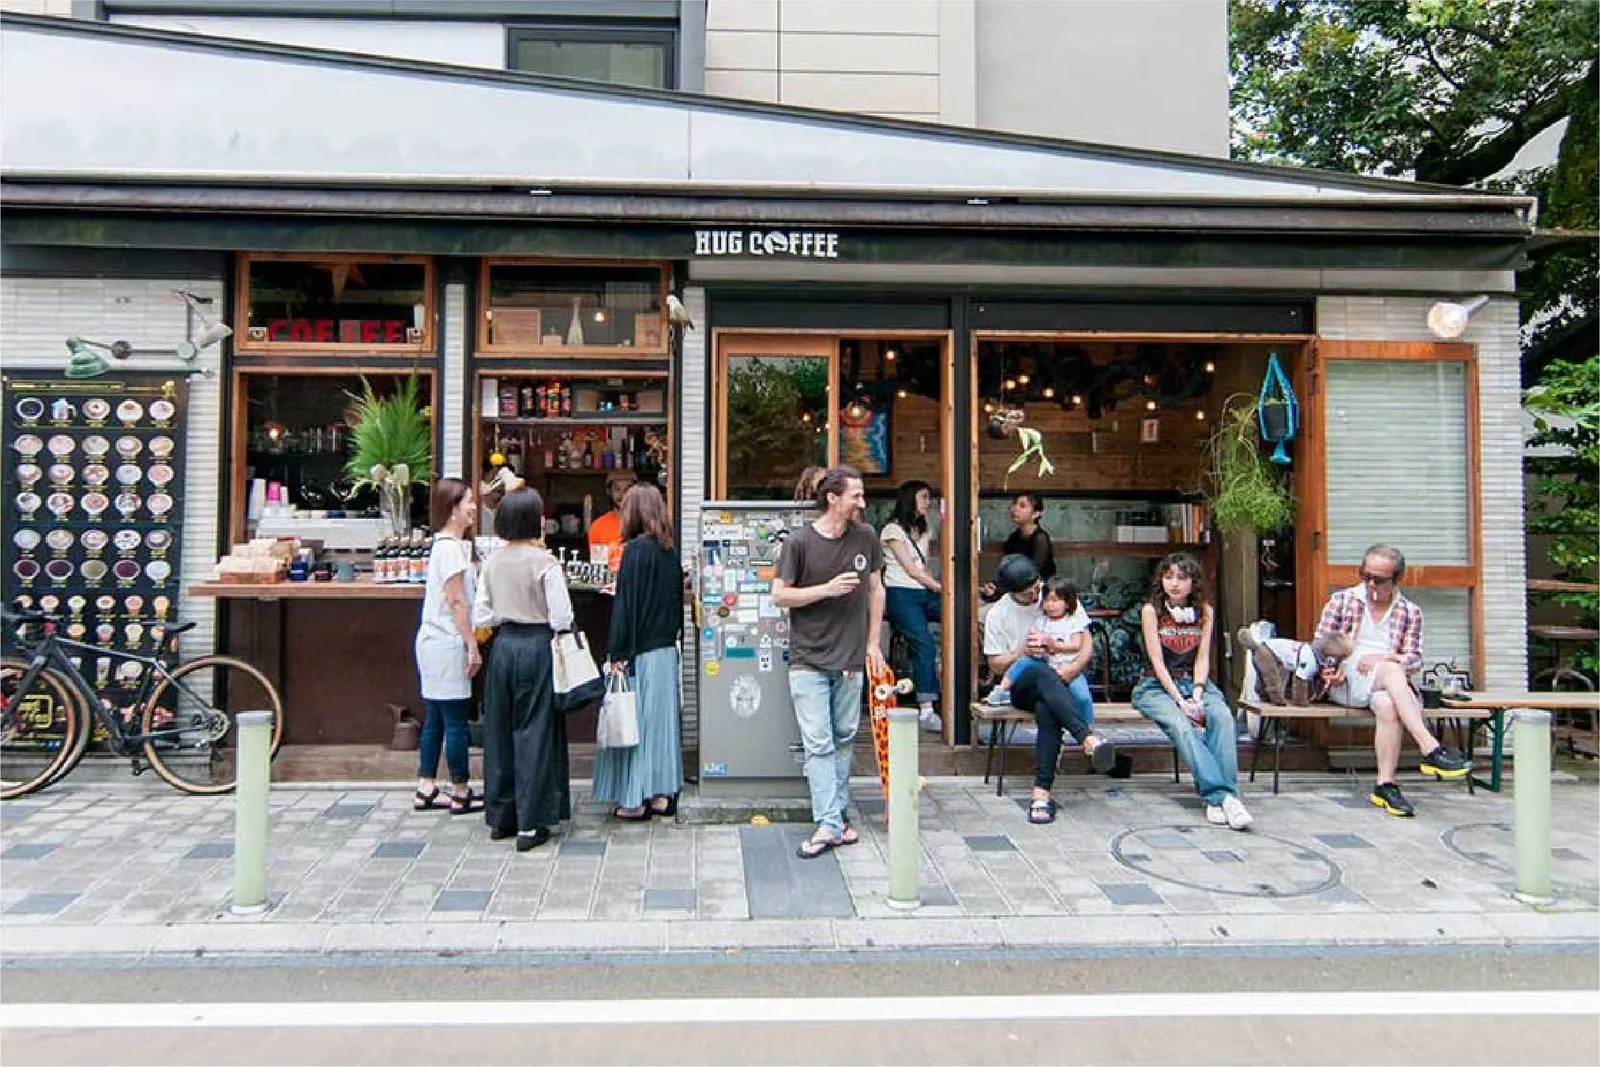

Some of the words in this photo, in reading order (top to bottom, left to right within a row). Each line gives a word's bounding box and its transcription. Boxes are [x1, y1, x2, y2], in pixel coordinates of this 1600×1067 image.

[695, 230, 742, 255] HUG
[749, 231, 838, 257] COFFEE
[269, 319, 405, 343] COFFEE
